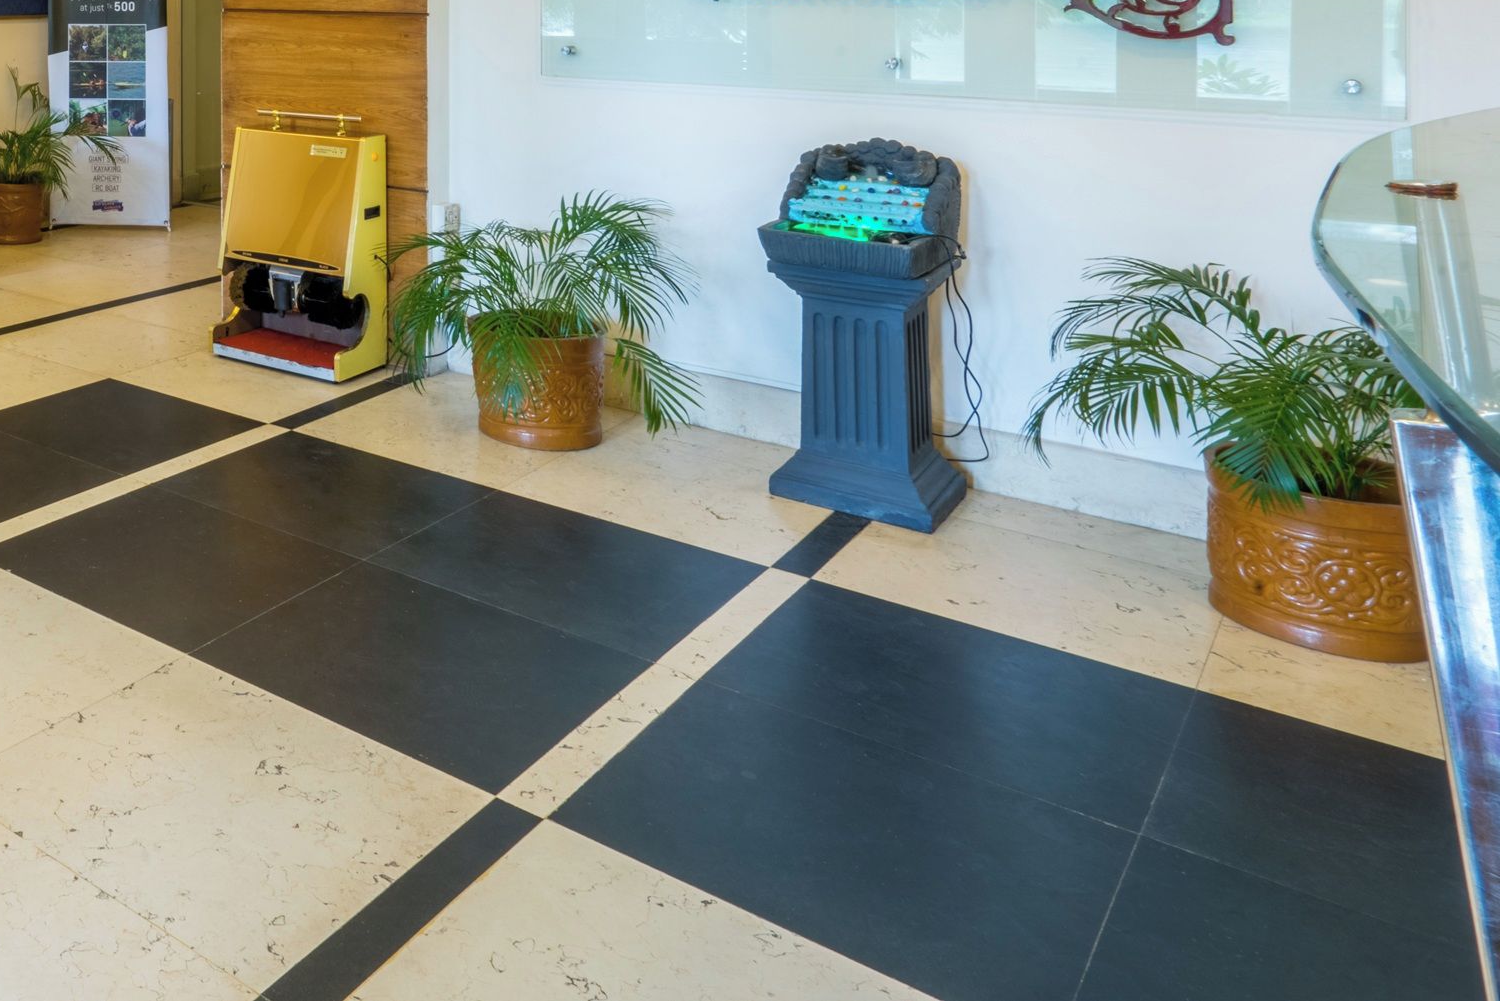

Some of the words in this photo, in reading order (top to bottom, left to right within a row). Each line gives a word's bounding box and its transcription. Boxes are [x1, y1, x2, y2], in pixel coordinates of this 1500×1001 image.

[79, 4, 88, 12] at
[89, 3, 105, 12] just
[114, 1, 136, 12] 500
[106, 156, 126, 164] SING
